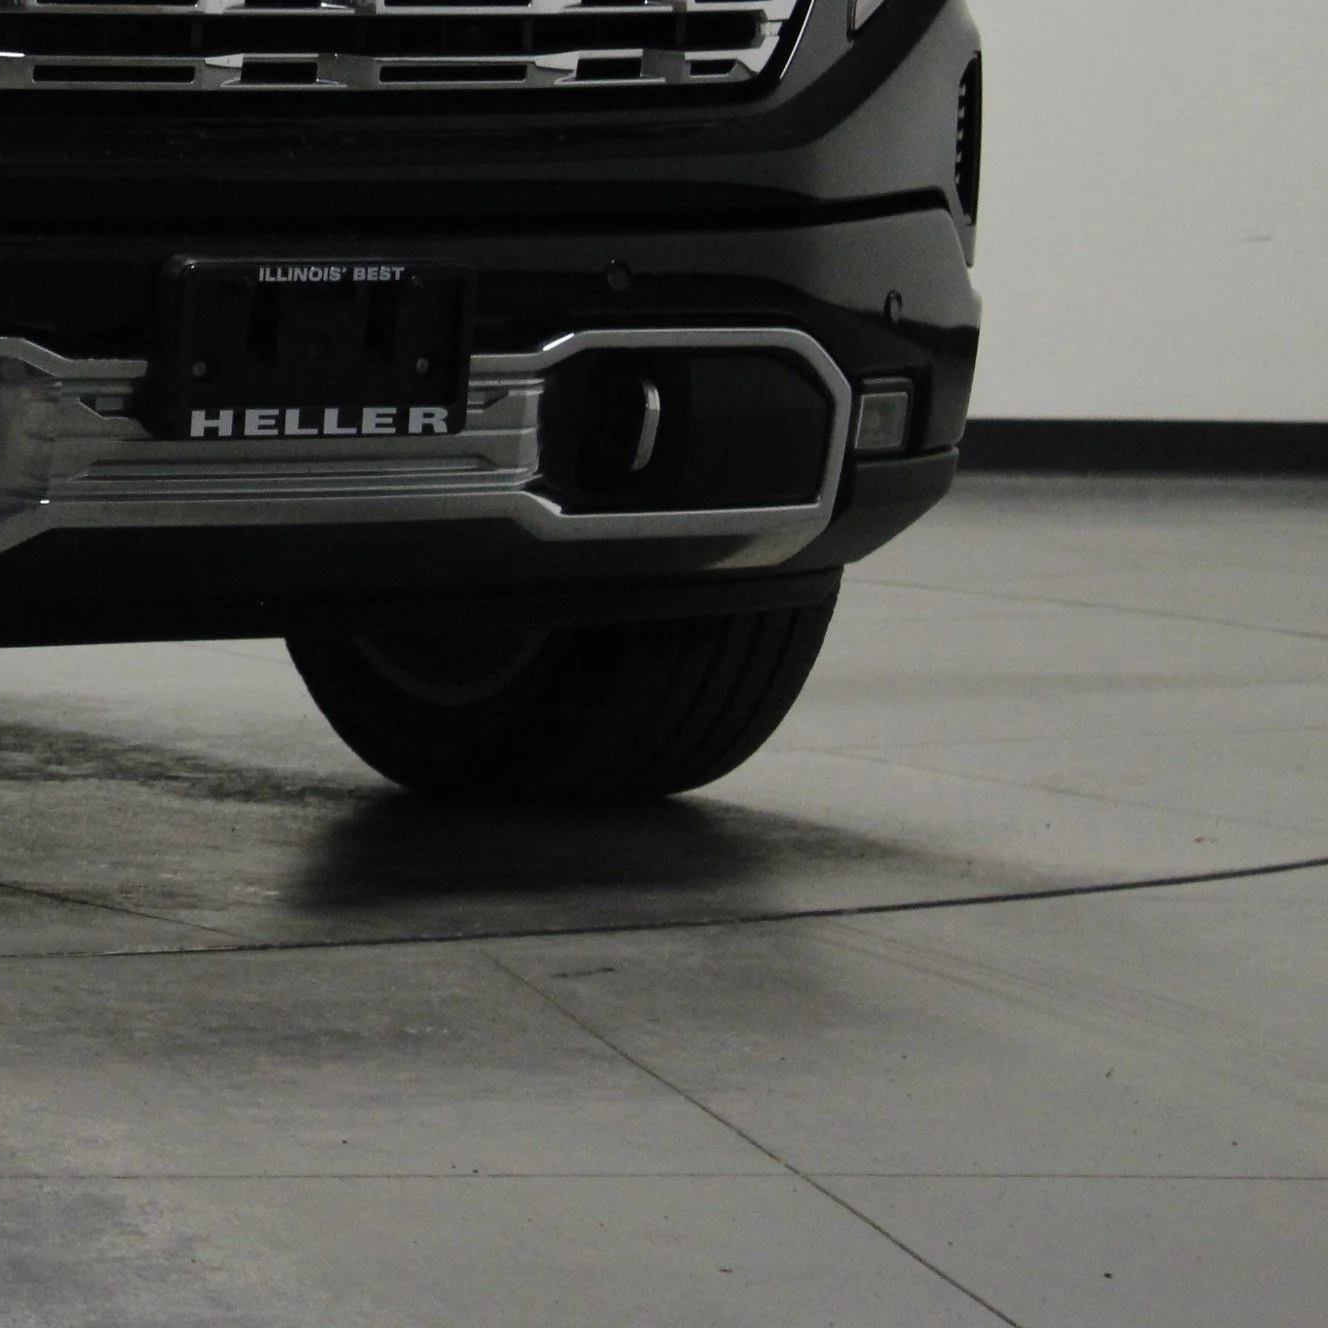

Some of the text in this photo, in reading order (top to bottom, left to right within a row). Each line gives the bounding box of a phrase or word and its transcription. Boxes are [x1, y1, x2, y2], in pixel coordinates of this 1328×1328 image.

[258, 266, 405, 282] ILLINOIS' BEST
[190, 407, 448, 437] HELLER
